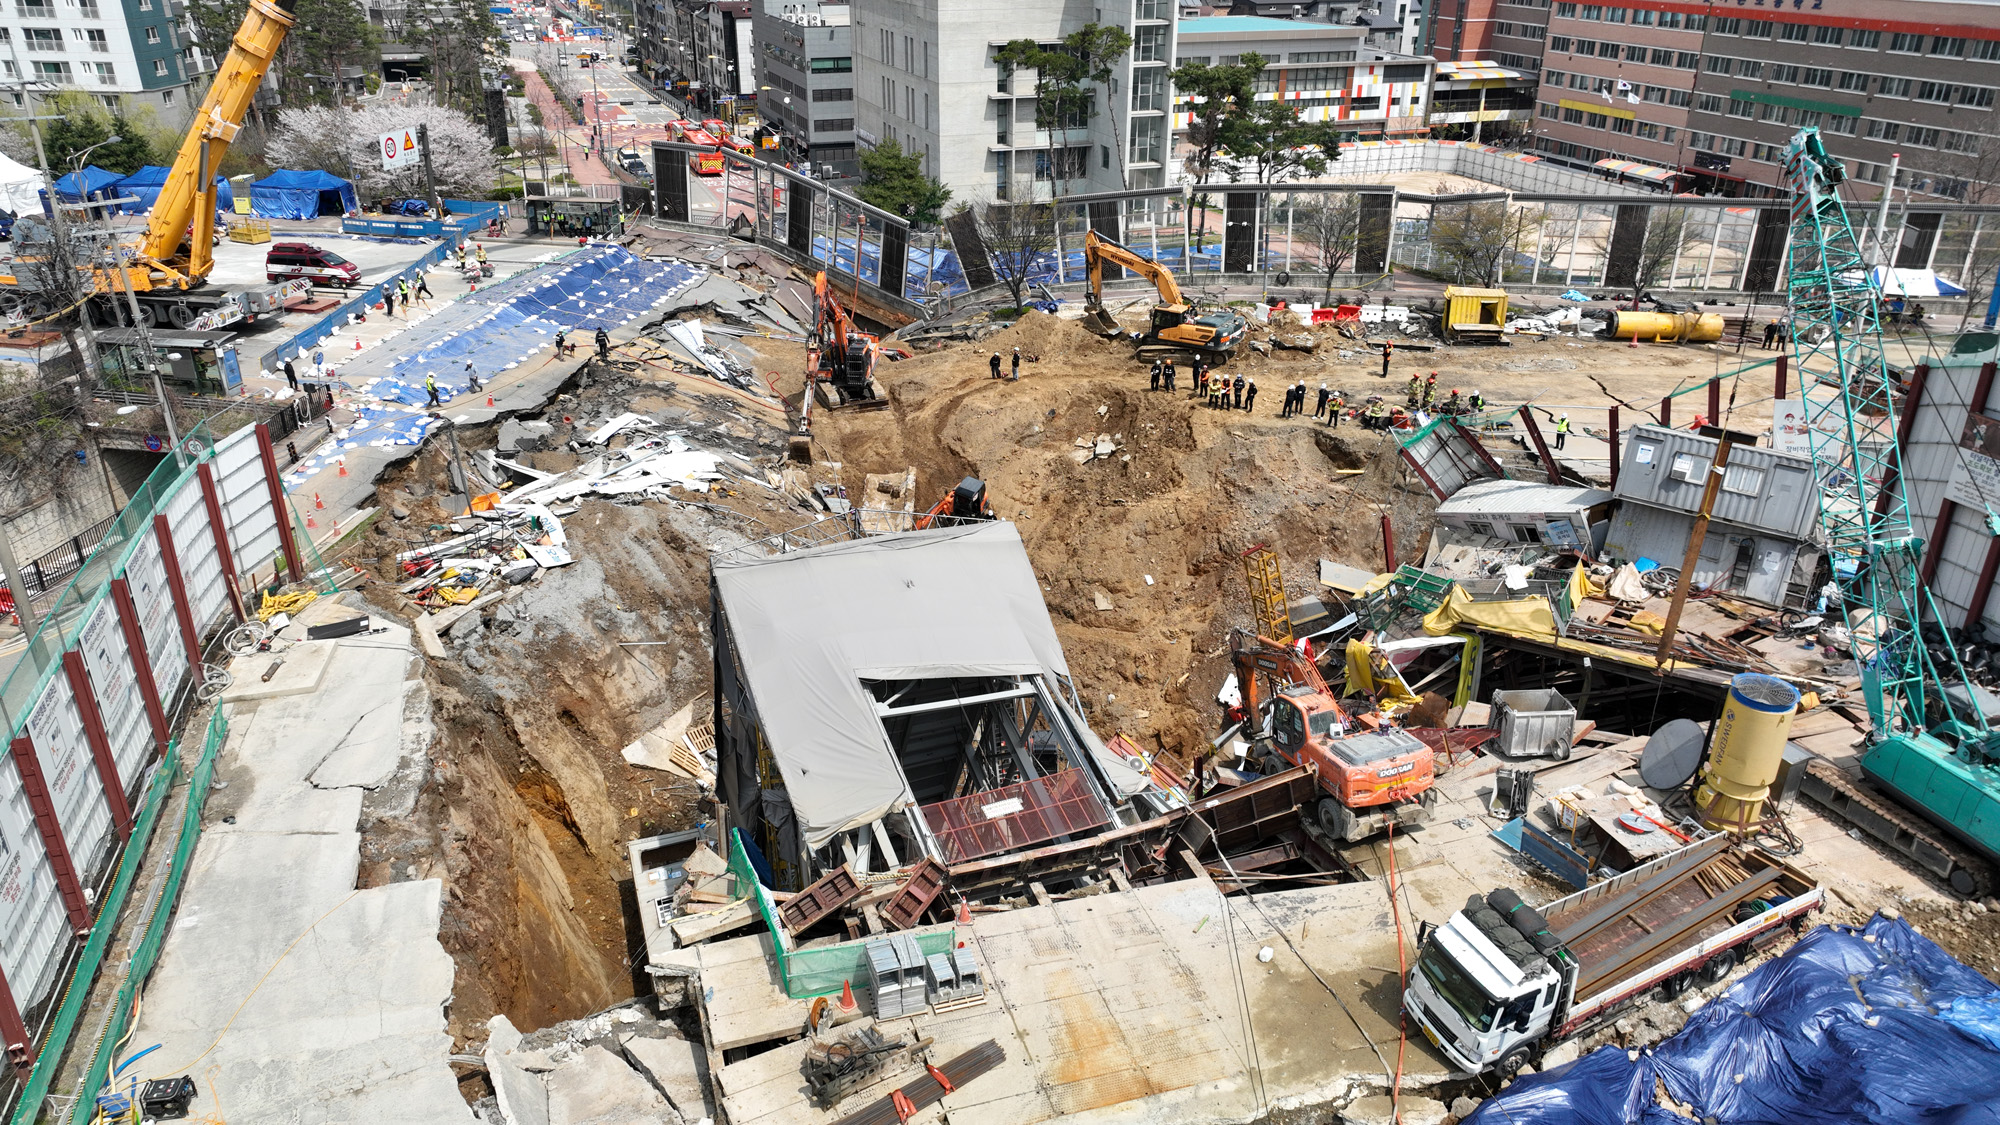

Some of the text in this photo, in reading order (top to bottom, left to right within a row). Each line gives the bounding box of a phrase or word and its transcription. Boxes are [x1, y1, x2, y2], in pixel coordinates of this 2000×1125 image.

[387, 142, 395, 152] 50
[1110, 253, 1135, 267] HYUNDAI
[190, 443, 202, 452] 30
[1491, 513, 1512, 521] 휴게실
[1258, 659, 1277, 670] DOOSAN
[1715, 721, 1733, 766] SWEDFAN
[1380, 762, 1413, 777] DOOSAN
